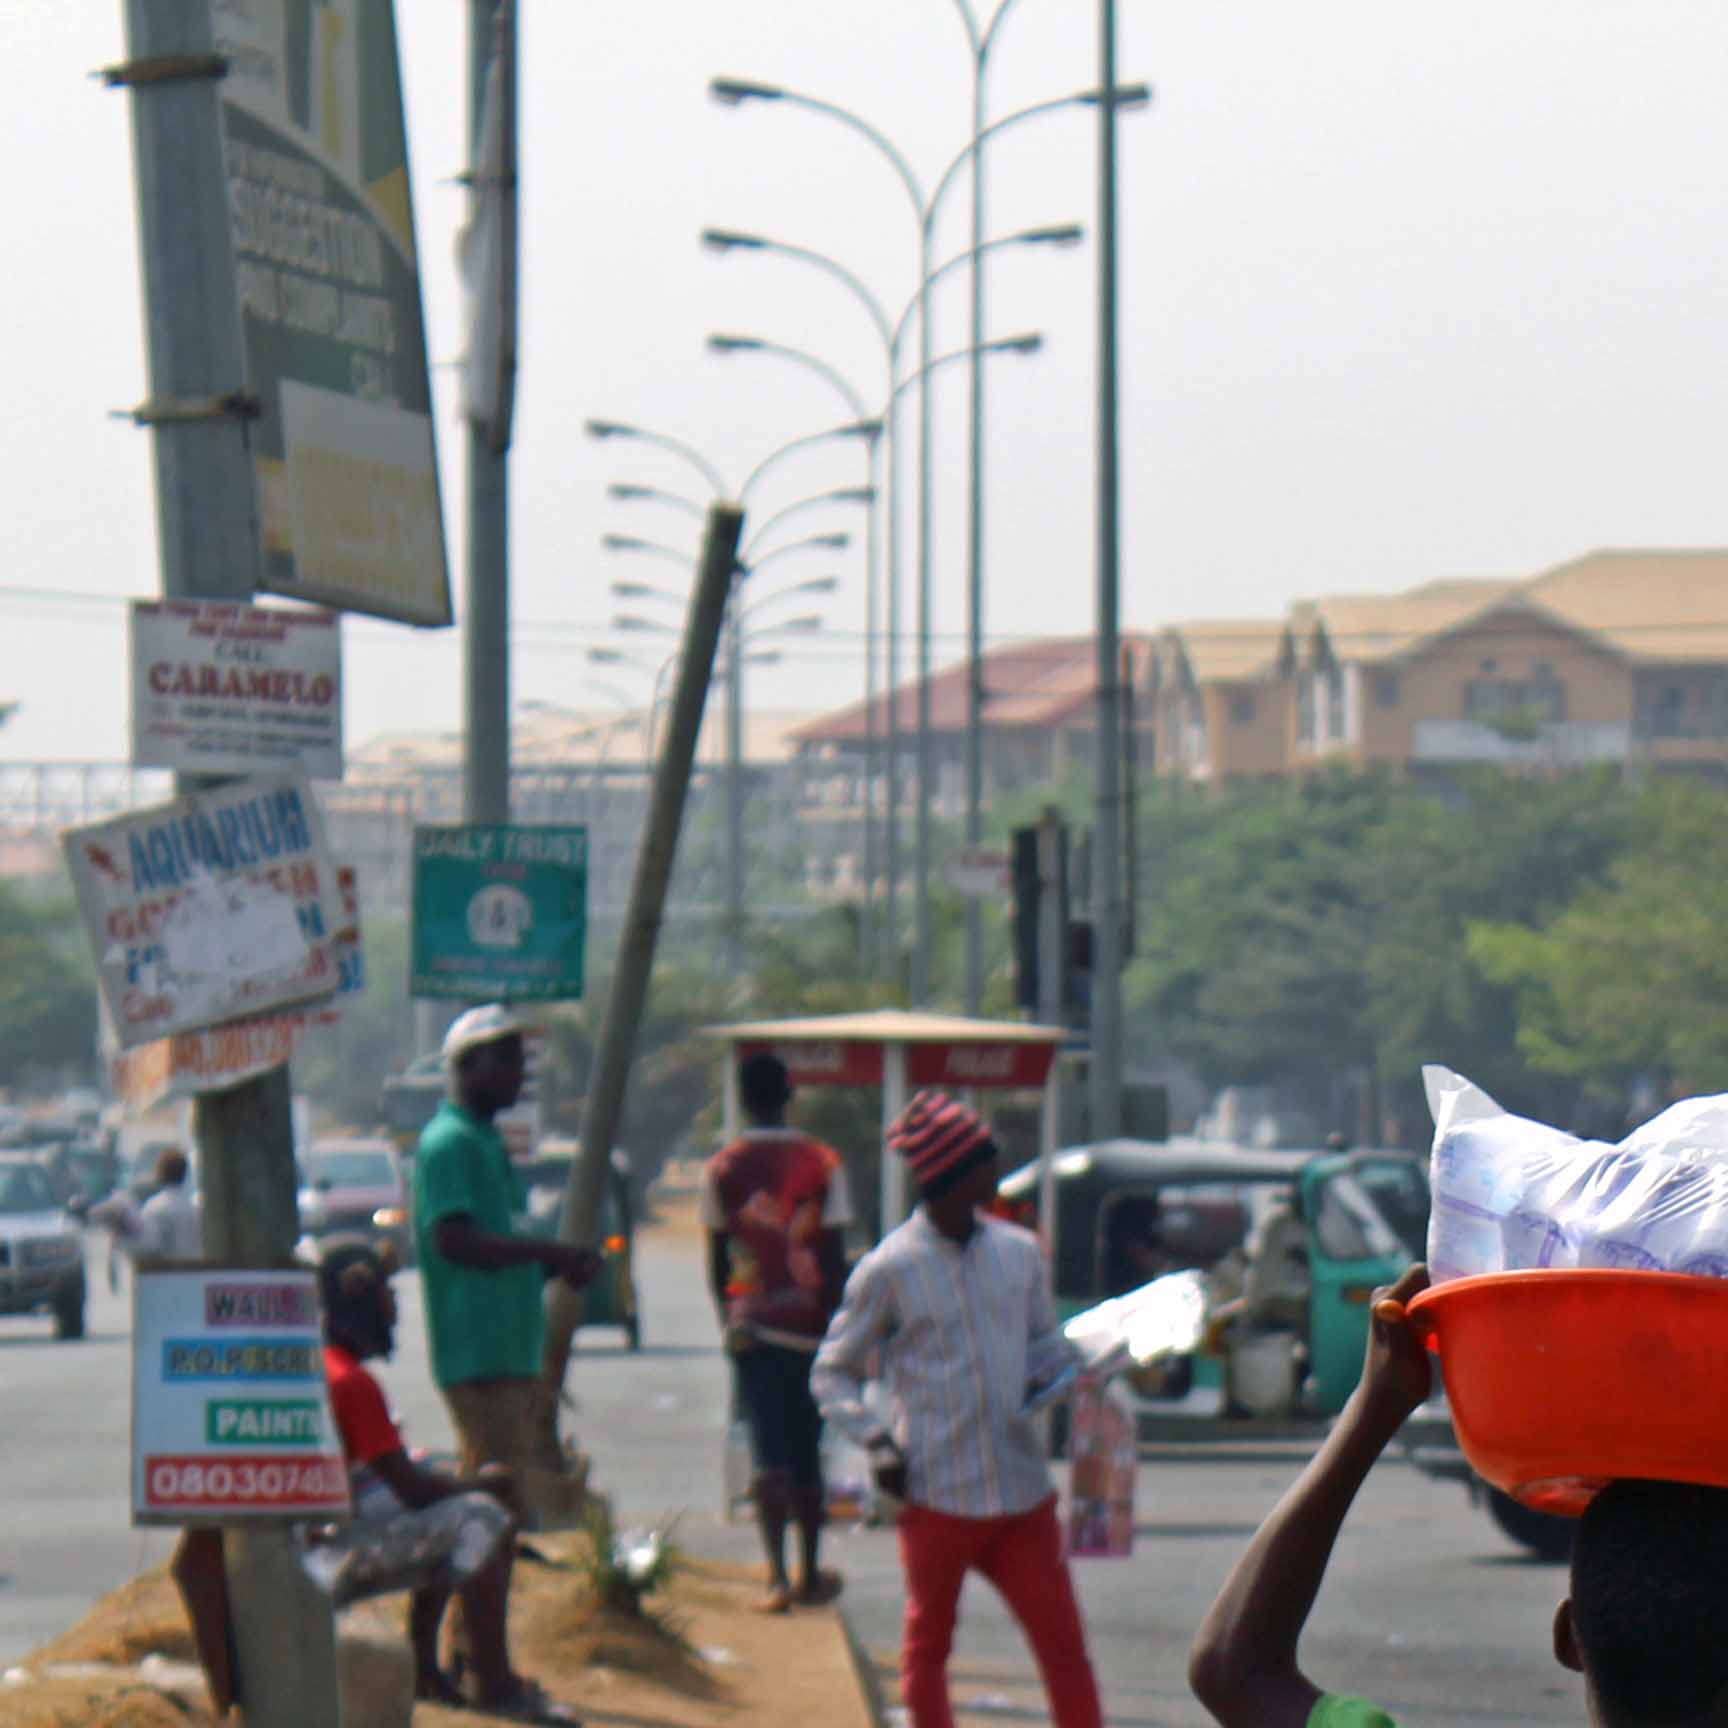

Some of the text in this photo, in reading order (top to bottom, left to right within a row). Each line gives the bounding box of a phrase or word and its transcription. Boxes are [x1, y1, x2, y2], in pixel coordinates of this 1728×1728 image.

[147, 660, 335, 706] CARAMELO
[129, 786, 313, 893] AQUARIUM
[416, 831, 590, 865] DAILY TRUST
